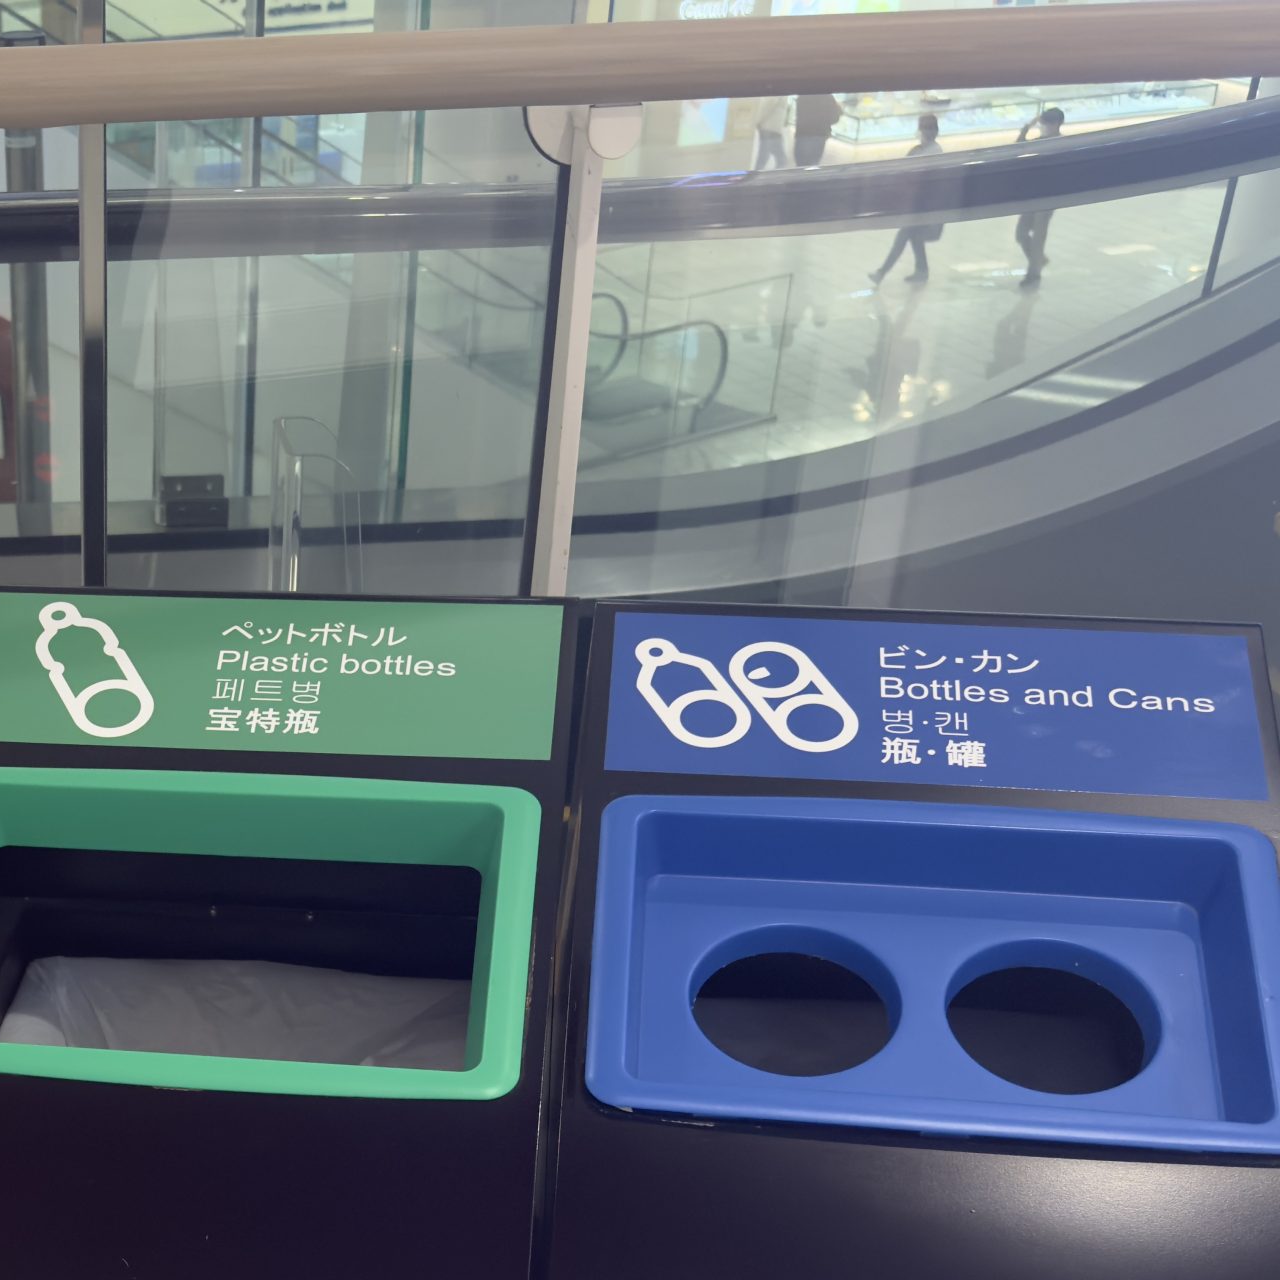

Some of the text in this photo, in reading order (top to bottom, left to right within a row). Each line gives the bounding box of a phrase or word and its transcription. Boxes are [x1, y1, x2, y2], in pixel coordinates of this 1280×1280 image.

[221, 620, 408, 647] ペットボトル
[216, 649, 457, 677] Plastic bottles
[879, 676, 1216, 713] Bottles and Cans
[205, 706, 321, 735] 宝特瓶
